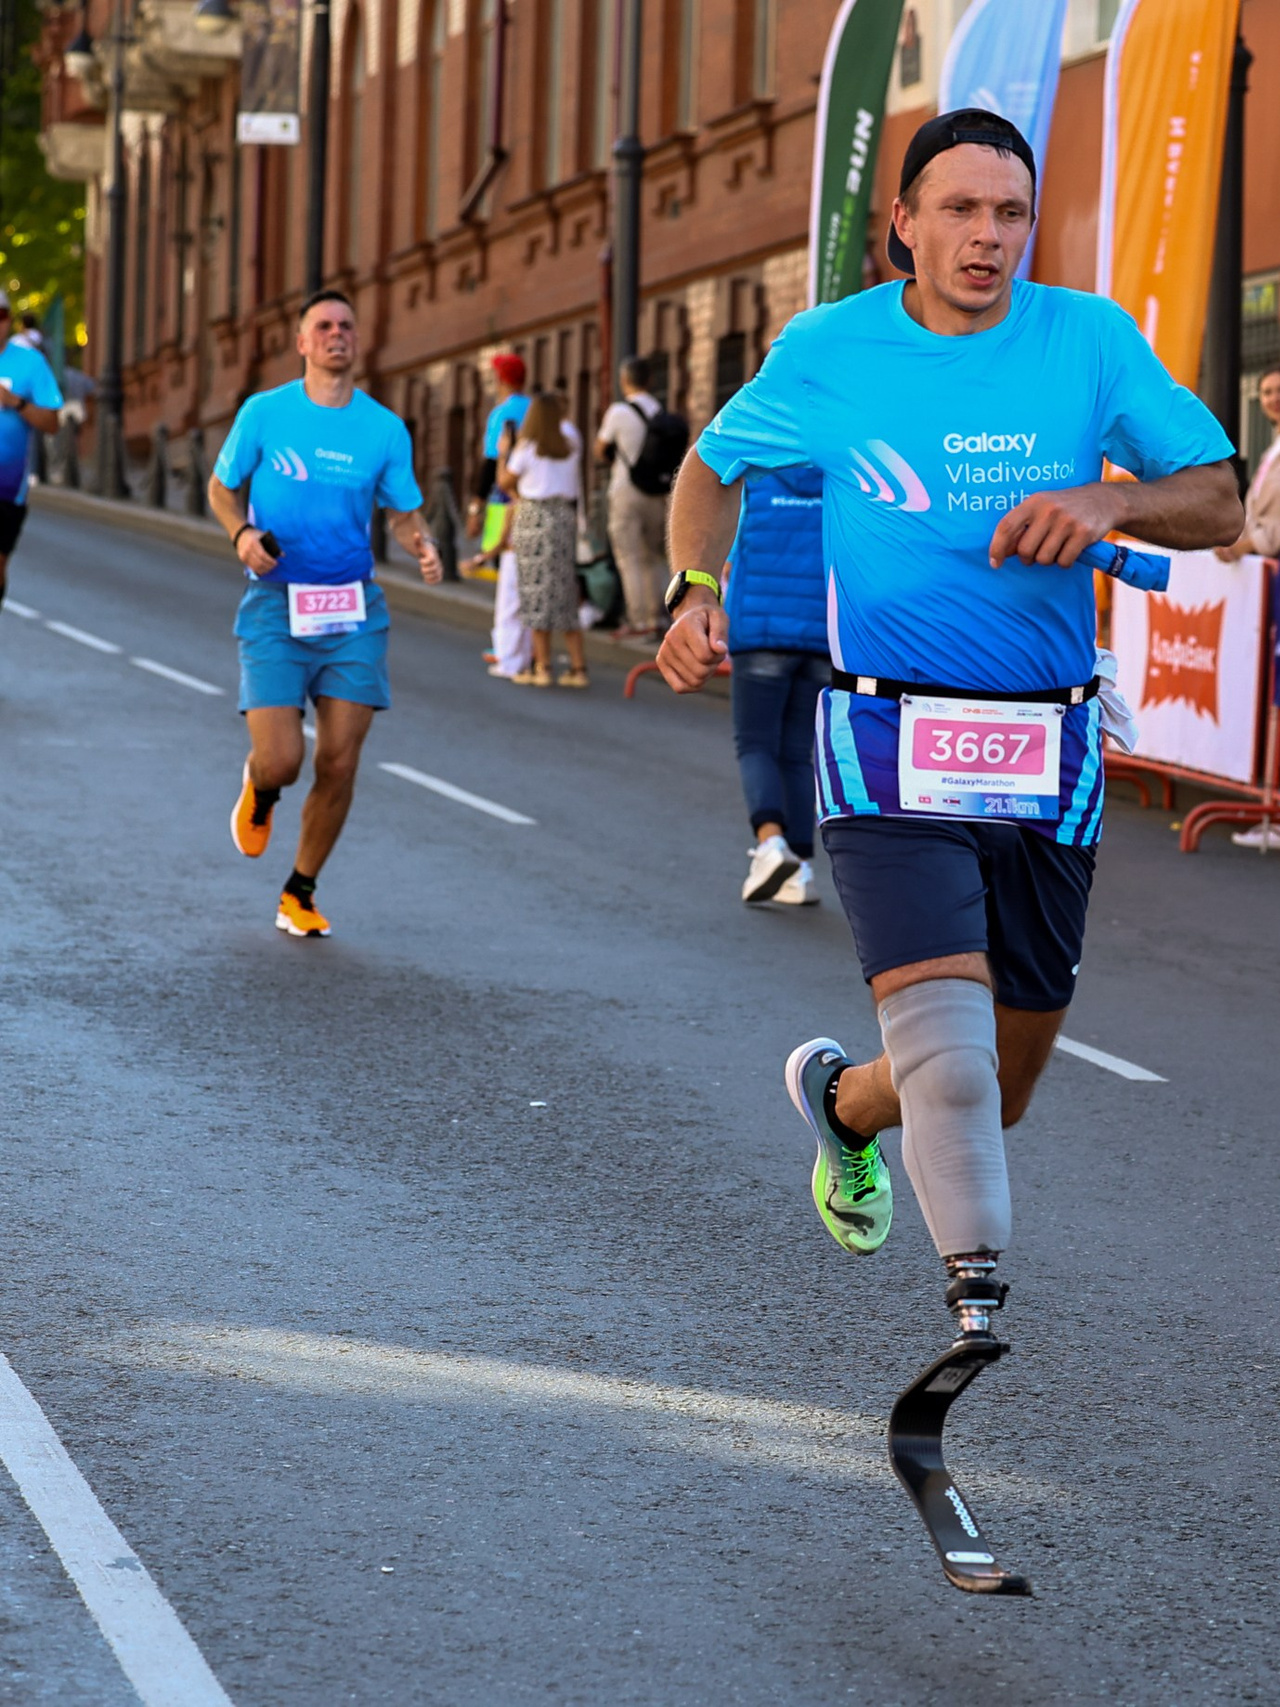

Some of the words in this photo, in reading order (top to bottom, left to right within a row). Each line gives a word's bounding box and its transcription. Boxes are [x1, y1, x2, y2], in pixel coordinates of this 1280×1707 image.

[943, 431, 1037, 458] Galaxy
[945, 458, 1076, 484] Vladivostok
[304, 591, 351, 612] 3722
[929, 729, 1031, 765] 3667
[941, 777, 1015, 787] #GalaxyMarathon
